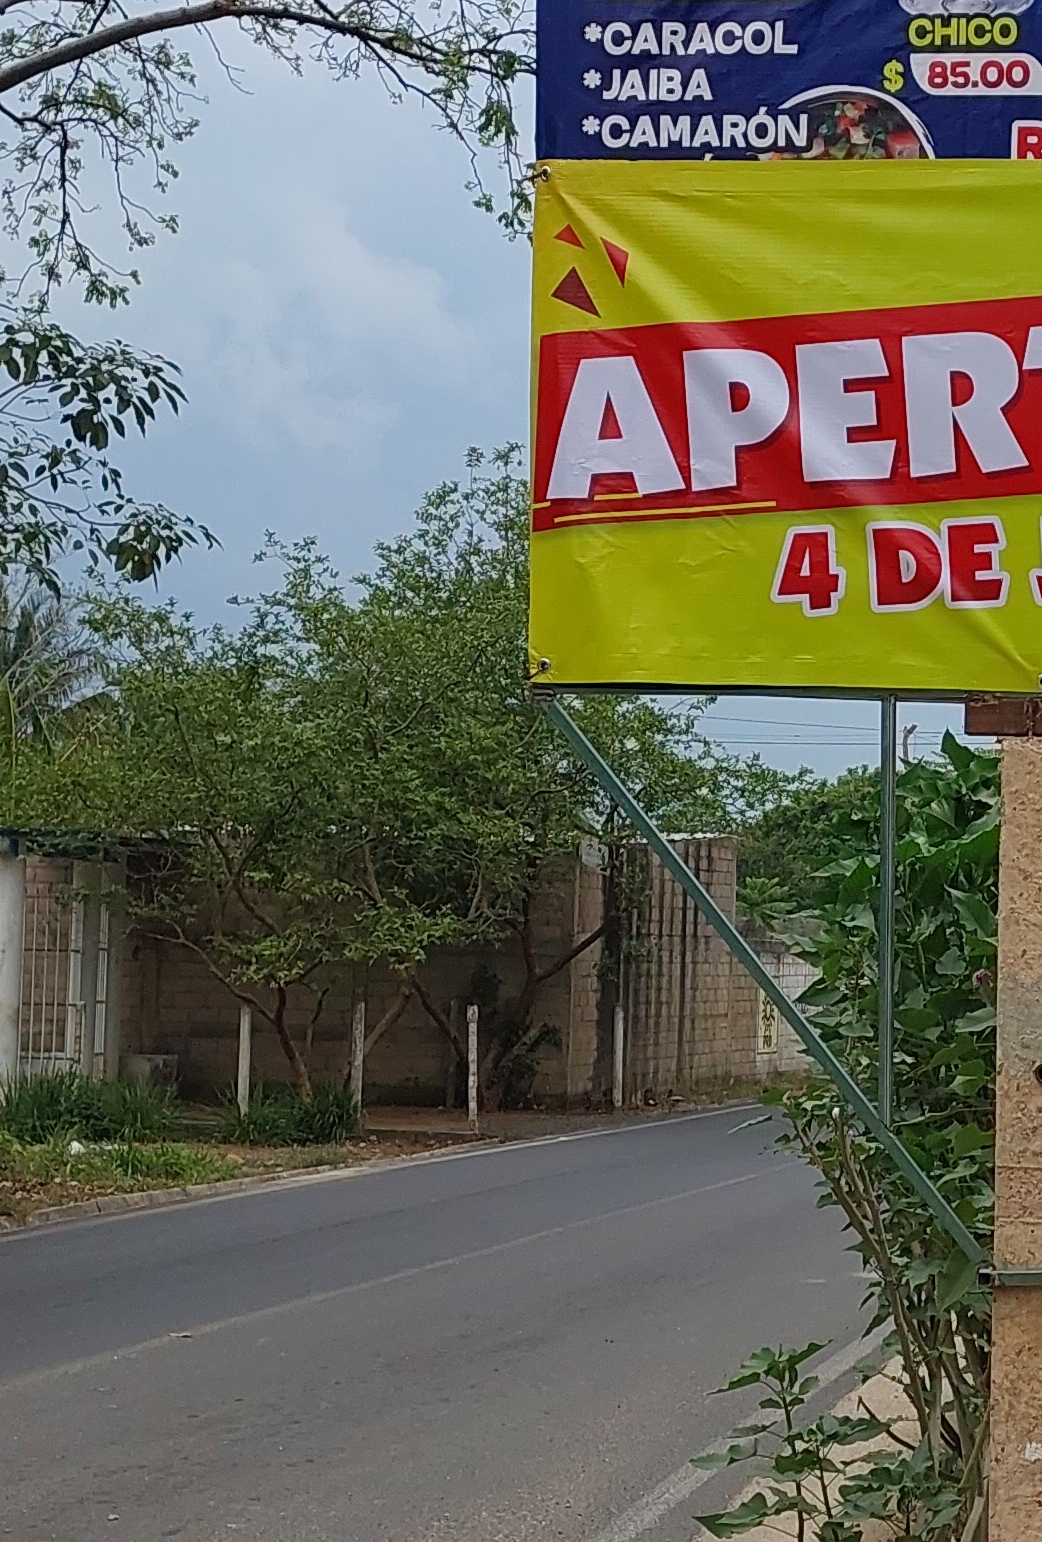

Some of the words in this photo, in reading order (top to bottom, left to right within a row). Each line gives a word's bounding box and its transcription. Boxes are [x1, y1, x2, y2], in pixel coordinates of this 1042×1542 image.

[908, 16, 1018, 48] CHICO
[883, 59, 905, 93] $
[926, 60, 1031, 90] 85.00
[770, 524, 846, 617] 4
[866, 515, 1009, 613] DE
